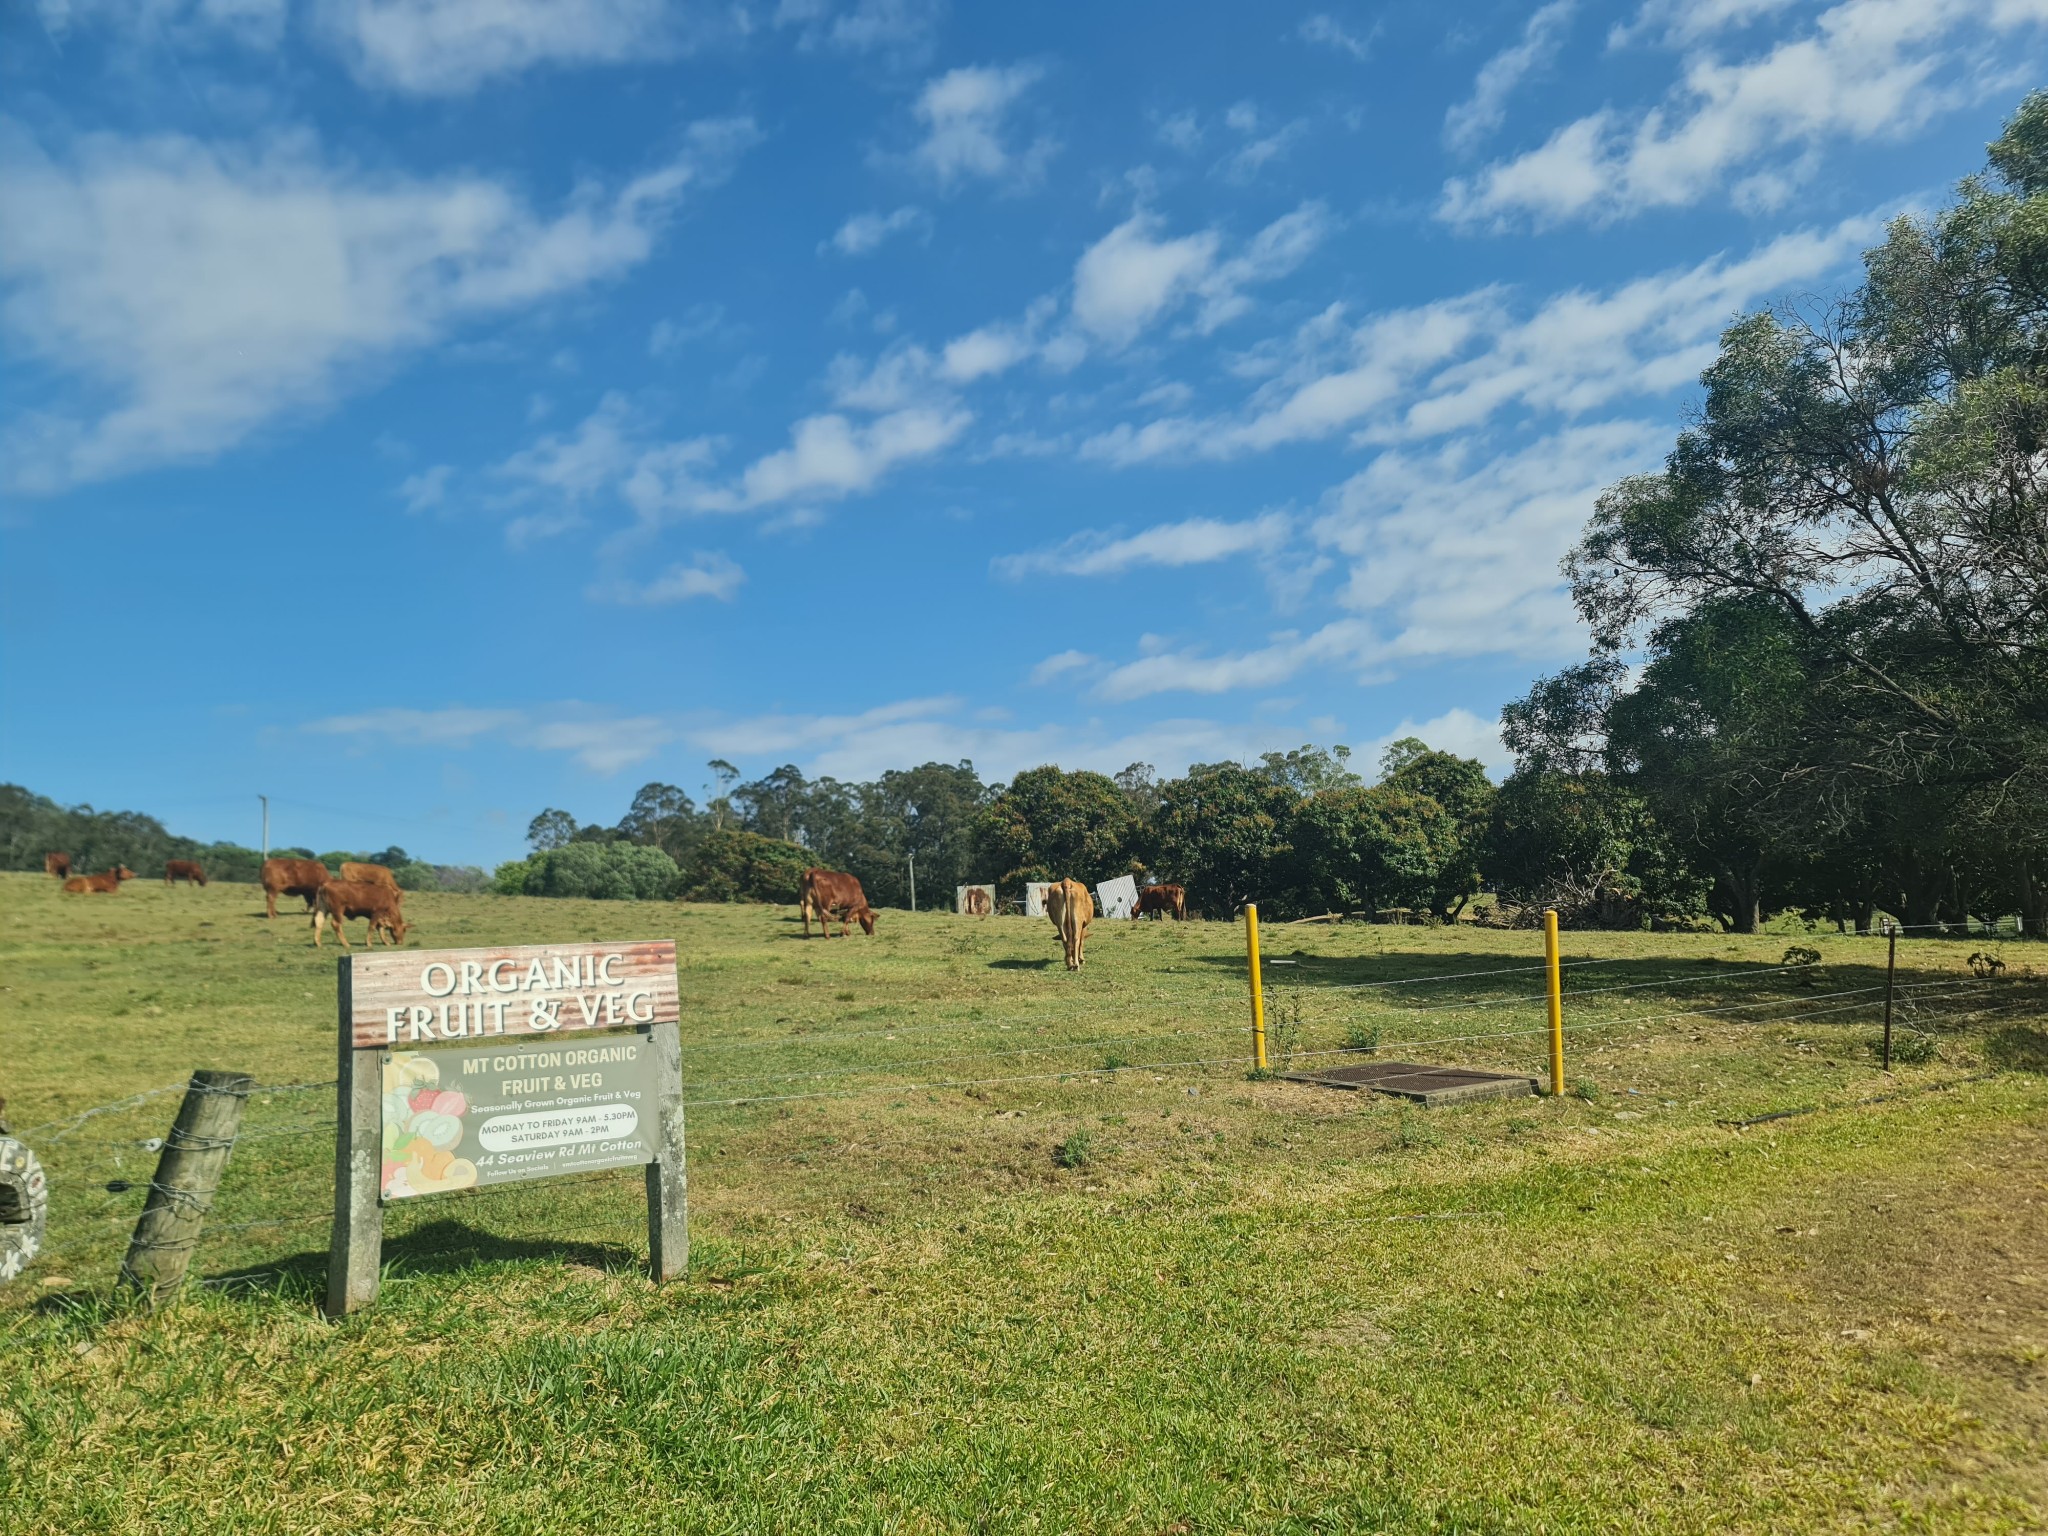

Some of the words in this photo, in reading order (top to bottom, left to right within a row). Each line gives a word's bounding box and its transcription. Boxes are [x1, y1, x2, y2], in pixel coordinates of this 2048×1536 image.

[420, 953, 624, 997] ORGANIC
[386, 1000, 511, 1042] FRUIT
[528, 998, 562, 1031] &
[575, 991, 654, 1027] VEG
[463, 1057, 489, 1075] MT
[493, 1052, 560, 1073] COTTON
[565, 1045, 637, 1065] ORGANIC
[502, 1076, 550, 1096] FRUIT
[554, 1075, 566, 1091] &
[570, 1072, 603, 1089] VEG
[471, 1100, 522, 1114] Seasonally
[524, 1100, 555, 1109] Grown
[556, 1096, 593, 1106] Organic
[594, 1092, 613, 1102] Fruit
[615, 1090, 622, 1099] &
[623, 1090, 641, 1099] Veg
[481, 1122, 525, 1135] MONDAY
[527, 1121, 540, 1131] TO
[542, 1117, 574, 1128] FRIDAY
[576, 1115, 597, 1124] 9AM
[603, 1110, 636, 1122] 5.30PM
[511, 1130, 560, 1144] SATURDAY
[562, 1128, 583, 1137] 9AM
[590, 1125, 609, 1134] 2PM
[475, 1155, 494, 1168] 44
[497, 1150, 556, 1165] Seaview
[559, 1144, 576, 1157] Rd
[578, 1143, 597, 1155] Mt
[600, 1140, 642, 1152] Cotton
[487, 1169, 508, 1178] Follow
[526, 1163, 549, 1173] Socials
